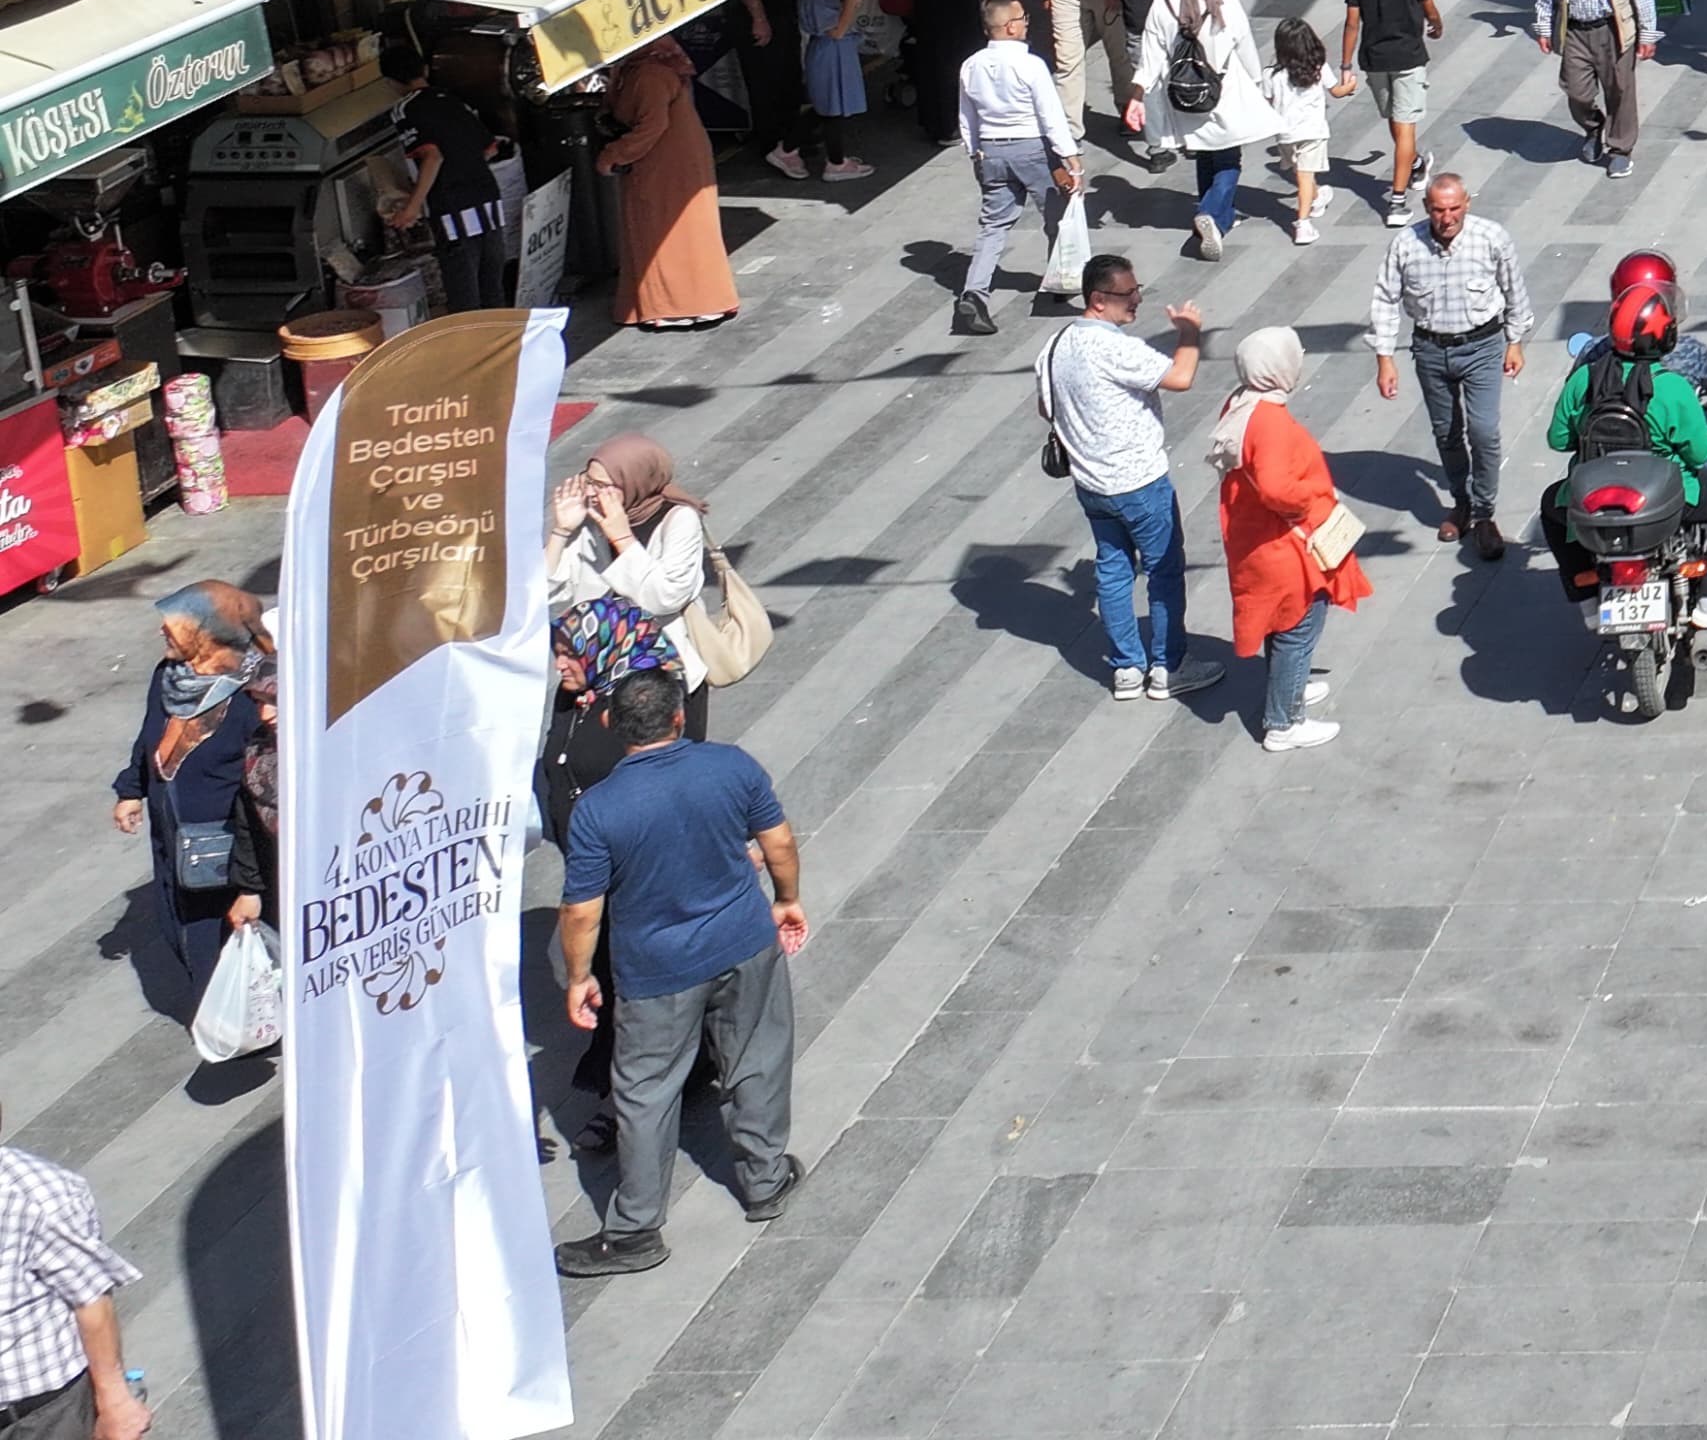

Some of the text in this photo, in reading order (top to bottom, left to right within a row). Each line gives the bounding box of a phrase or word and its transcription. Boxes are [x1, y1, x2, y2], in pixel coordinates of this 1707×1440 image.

[1, 40, 250, 177] KÖŞESİ Öztorun
[386, 394, 470, 427] Tarihi
[348, 425, 496, 465] Bedesten
[369, 458, 478, 494] Çarşısı
[402, 492, 445, 512] ve
[343, 509, 496, 552] Türbeönü
[351, 540, 486, 585] Çarşıları
[1617, 604, 1651, 622] 137
[323, 794, 512, 890] 4. KONYA TARİHİ
[302, 832, 510, 966] BEDESTEN
[302, 884, 504, 1004] ALIŞVERİŞ GÜNLERİ
